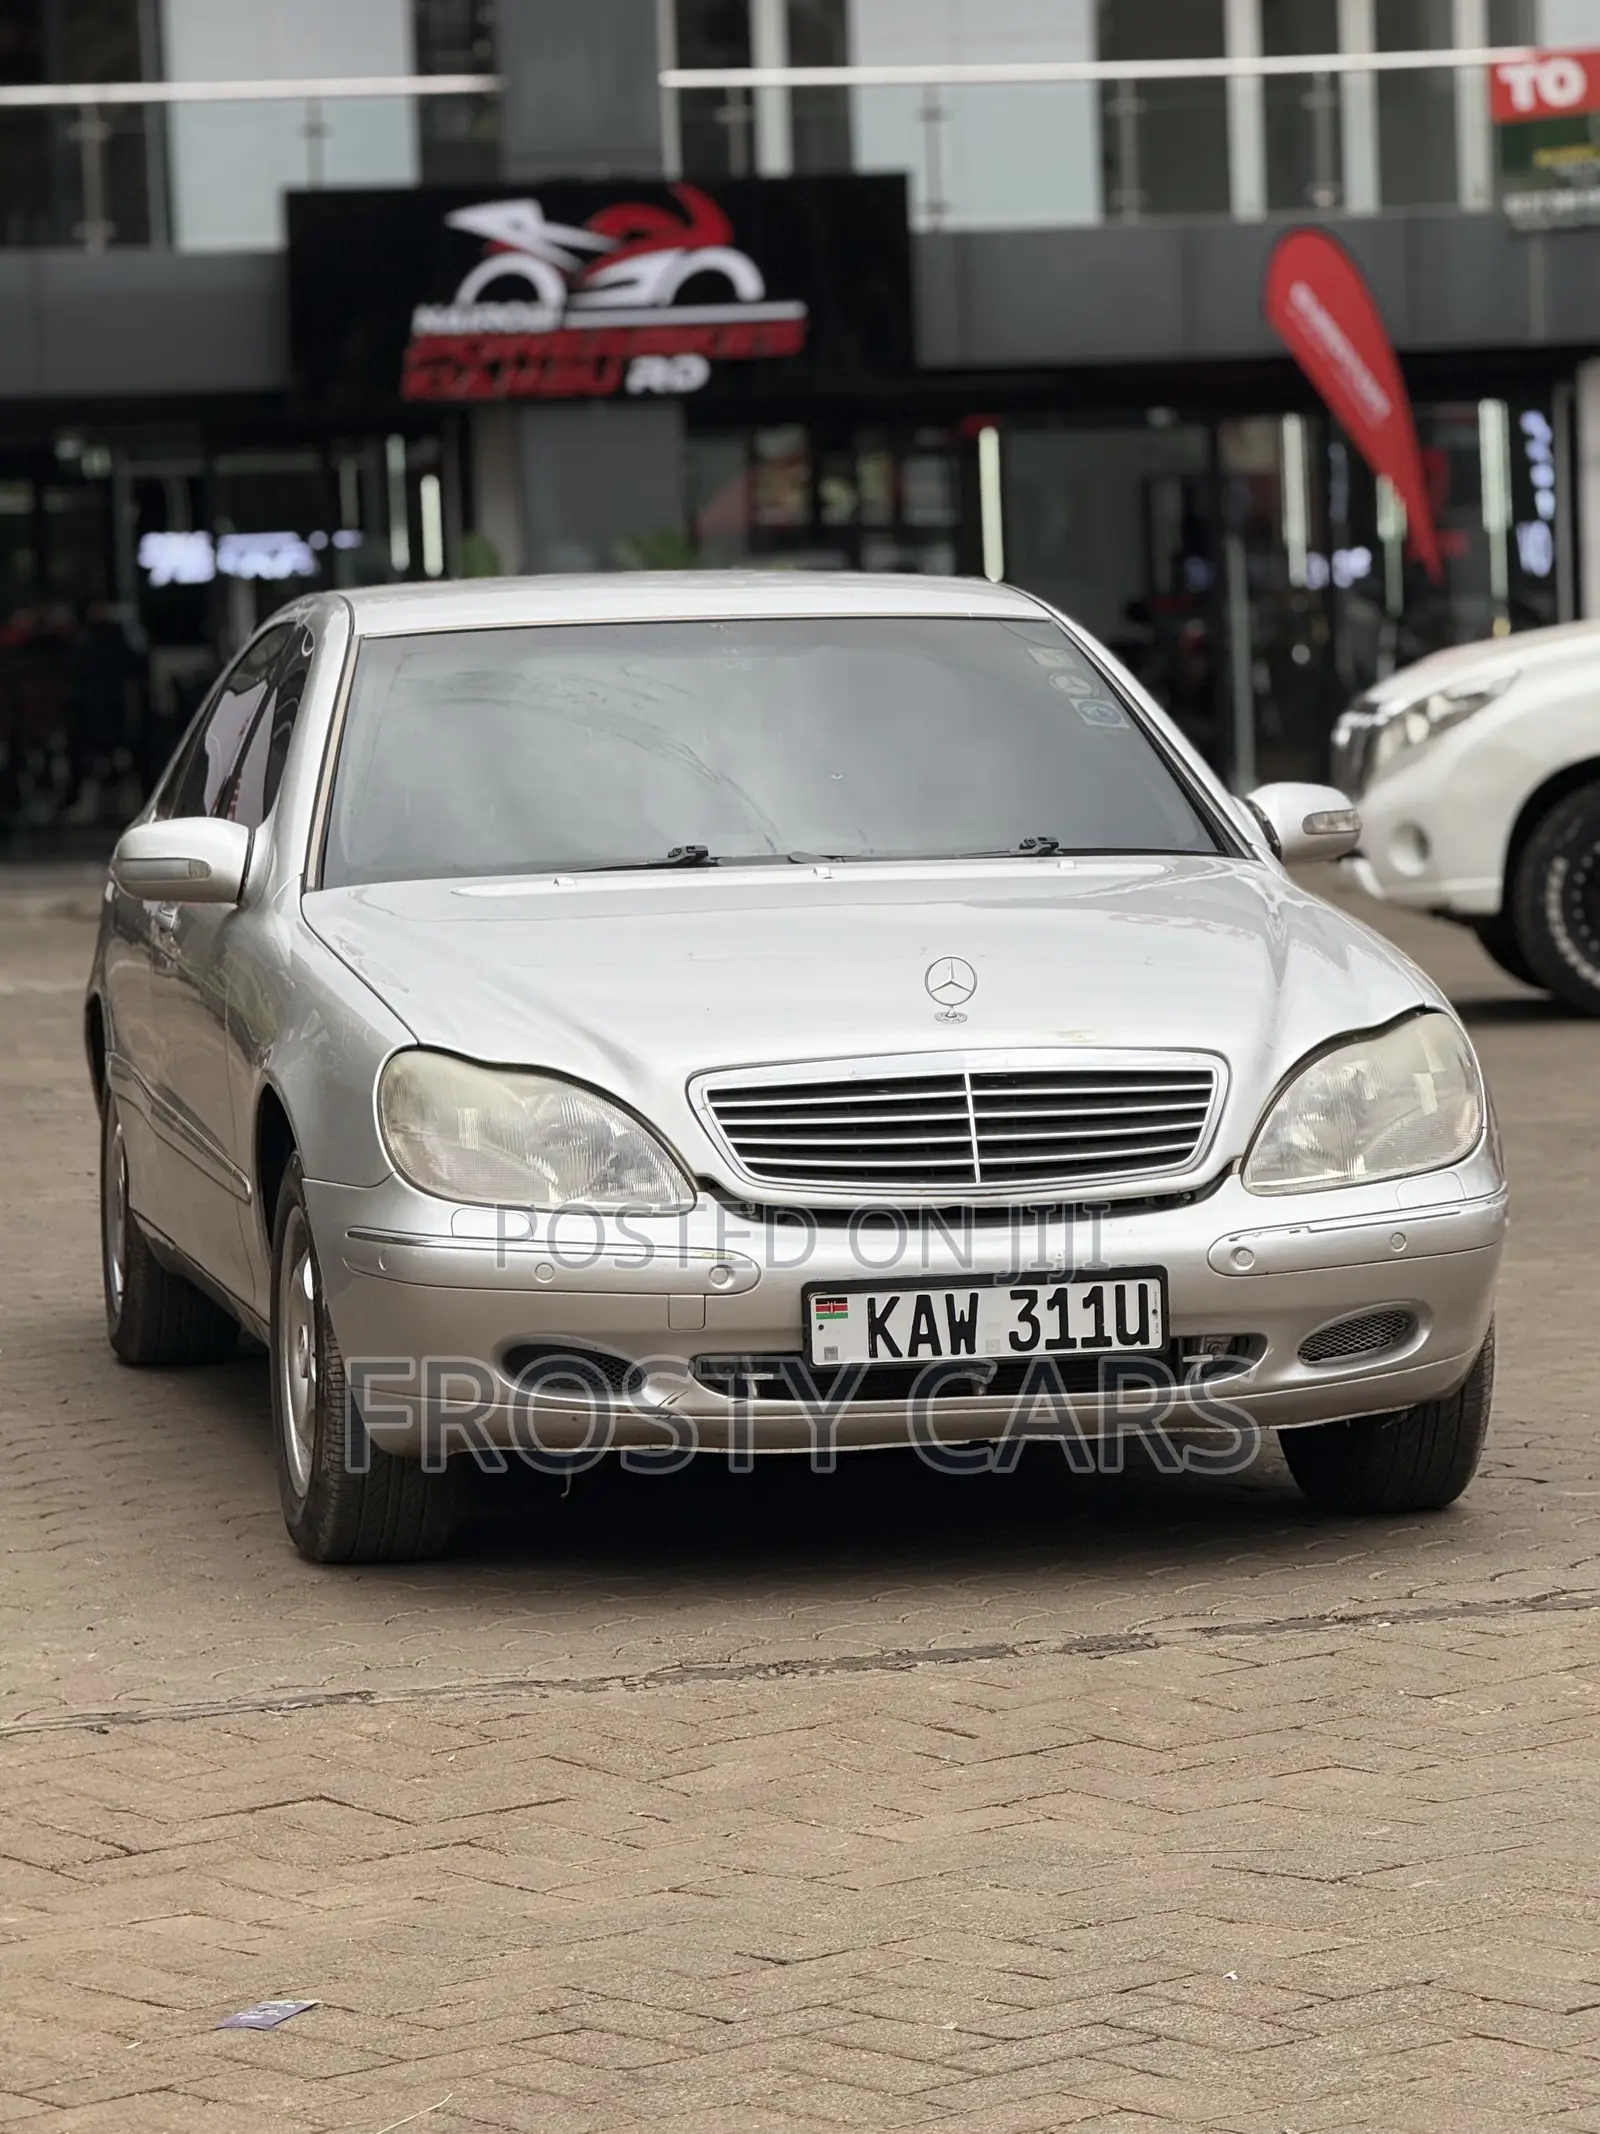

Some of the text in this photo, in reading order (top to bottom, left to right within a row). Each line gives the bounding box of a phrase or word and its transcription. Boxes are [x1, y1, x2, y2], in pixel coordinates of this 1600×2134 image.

[1497, 57, 1589, 112] TO
[866, 1291, 980, 1359] KAW
[1008, 1282, 1150, 1352] 311U
